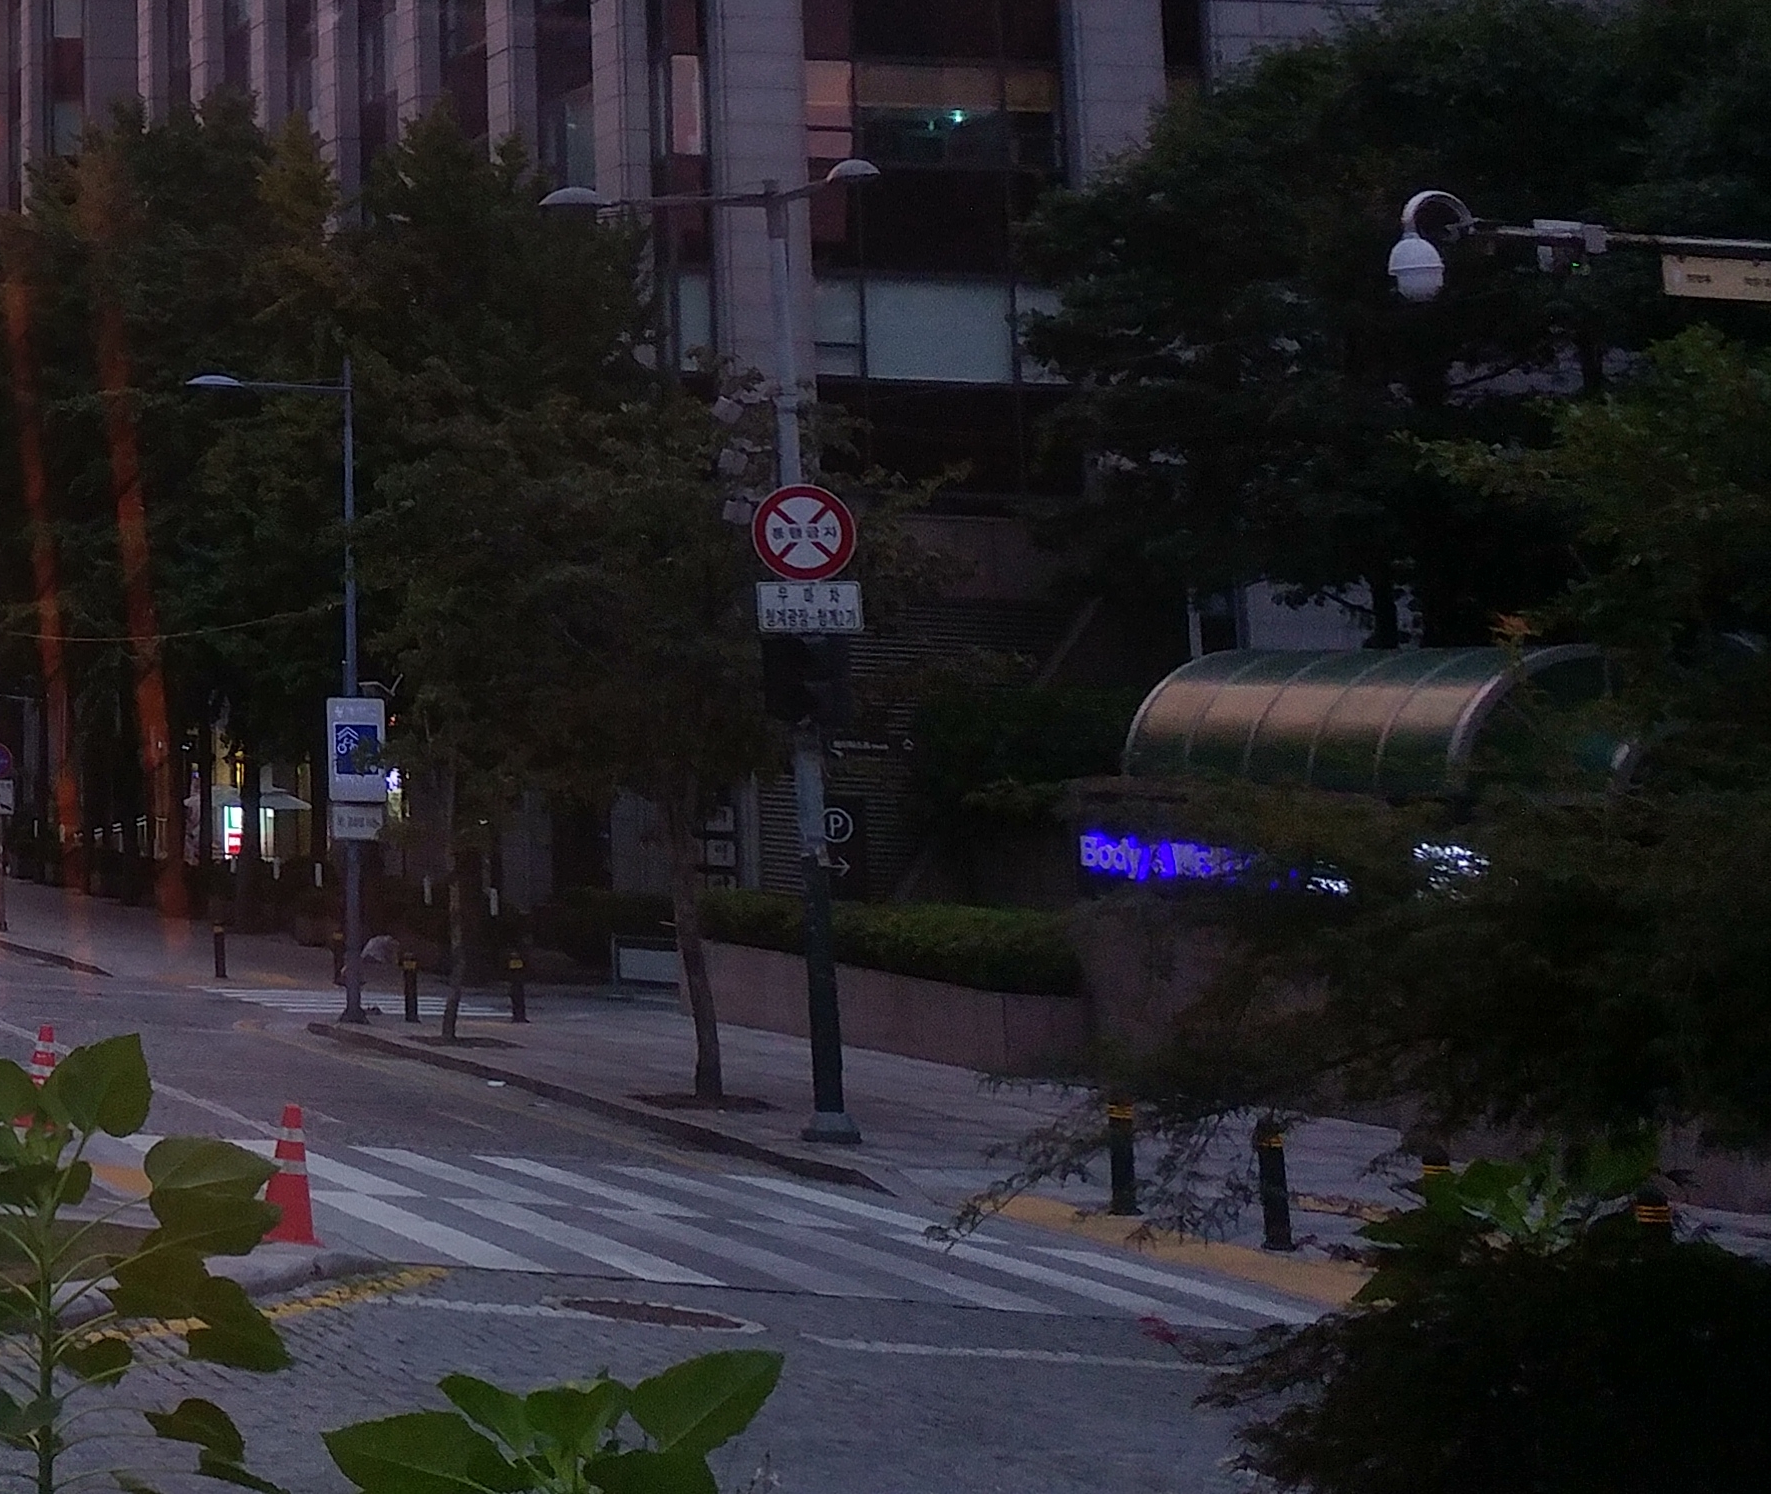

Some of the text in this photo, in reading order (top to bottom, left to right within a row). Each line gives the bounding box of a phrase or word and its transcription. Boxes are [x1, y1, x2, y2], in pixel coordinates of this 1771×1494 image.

[772, 526, 837, 540] 통행금지
[829, 814, 843, 837] P
[1080, 834, 1141, 881] Body
